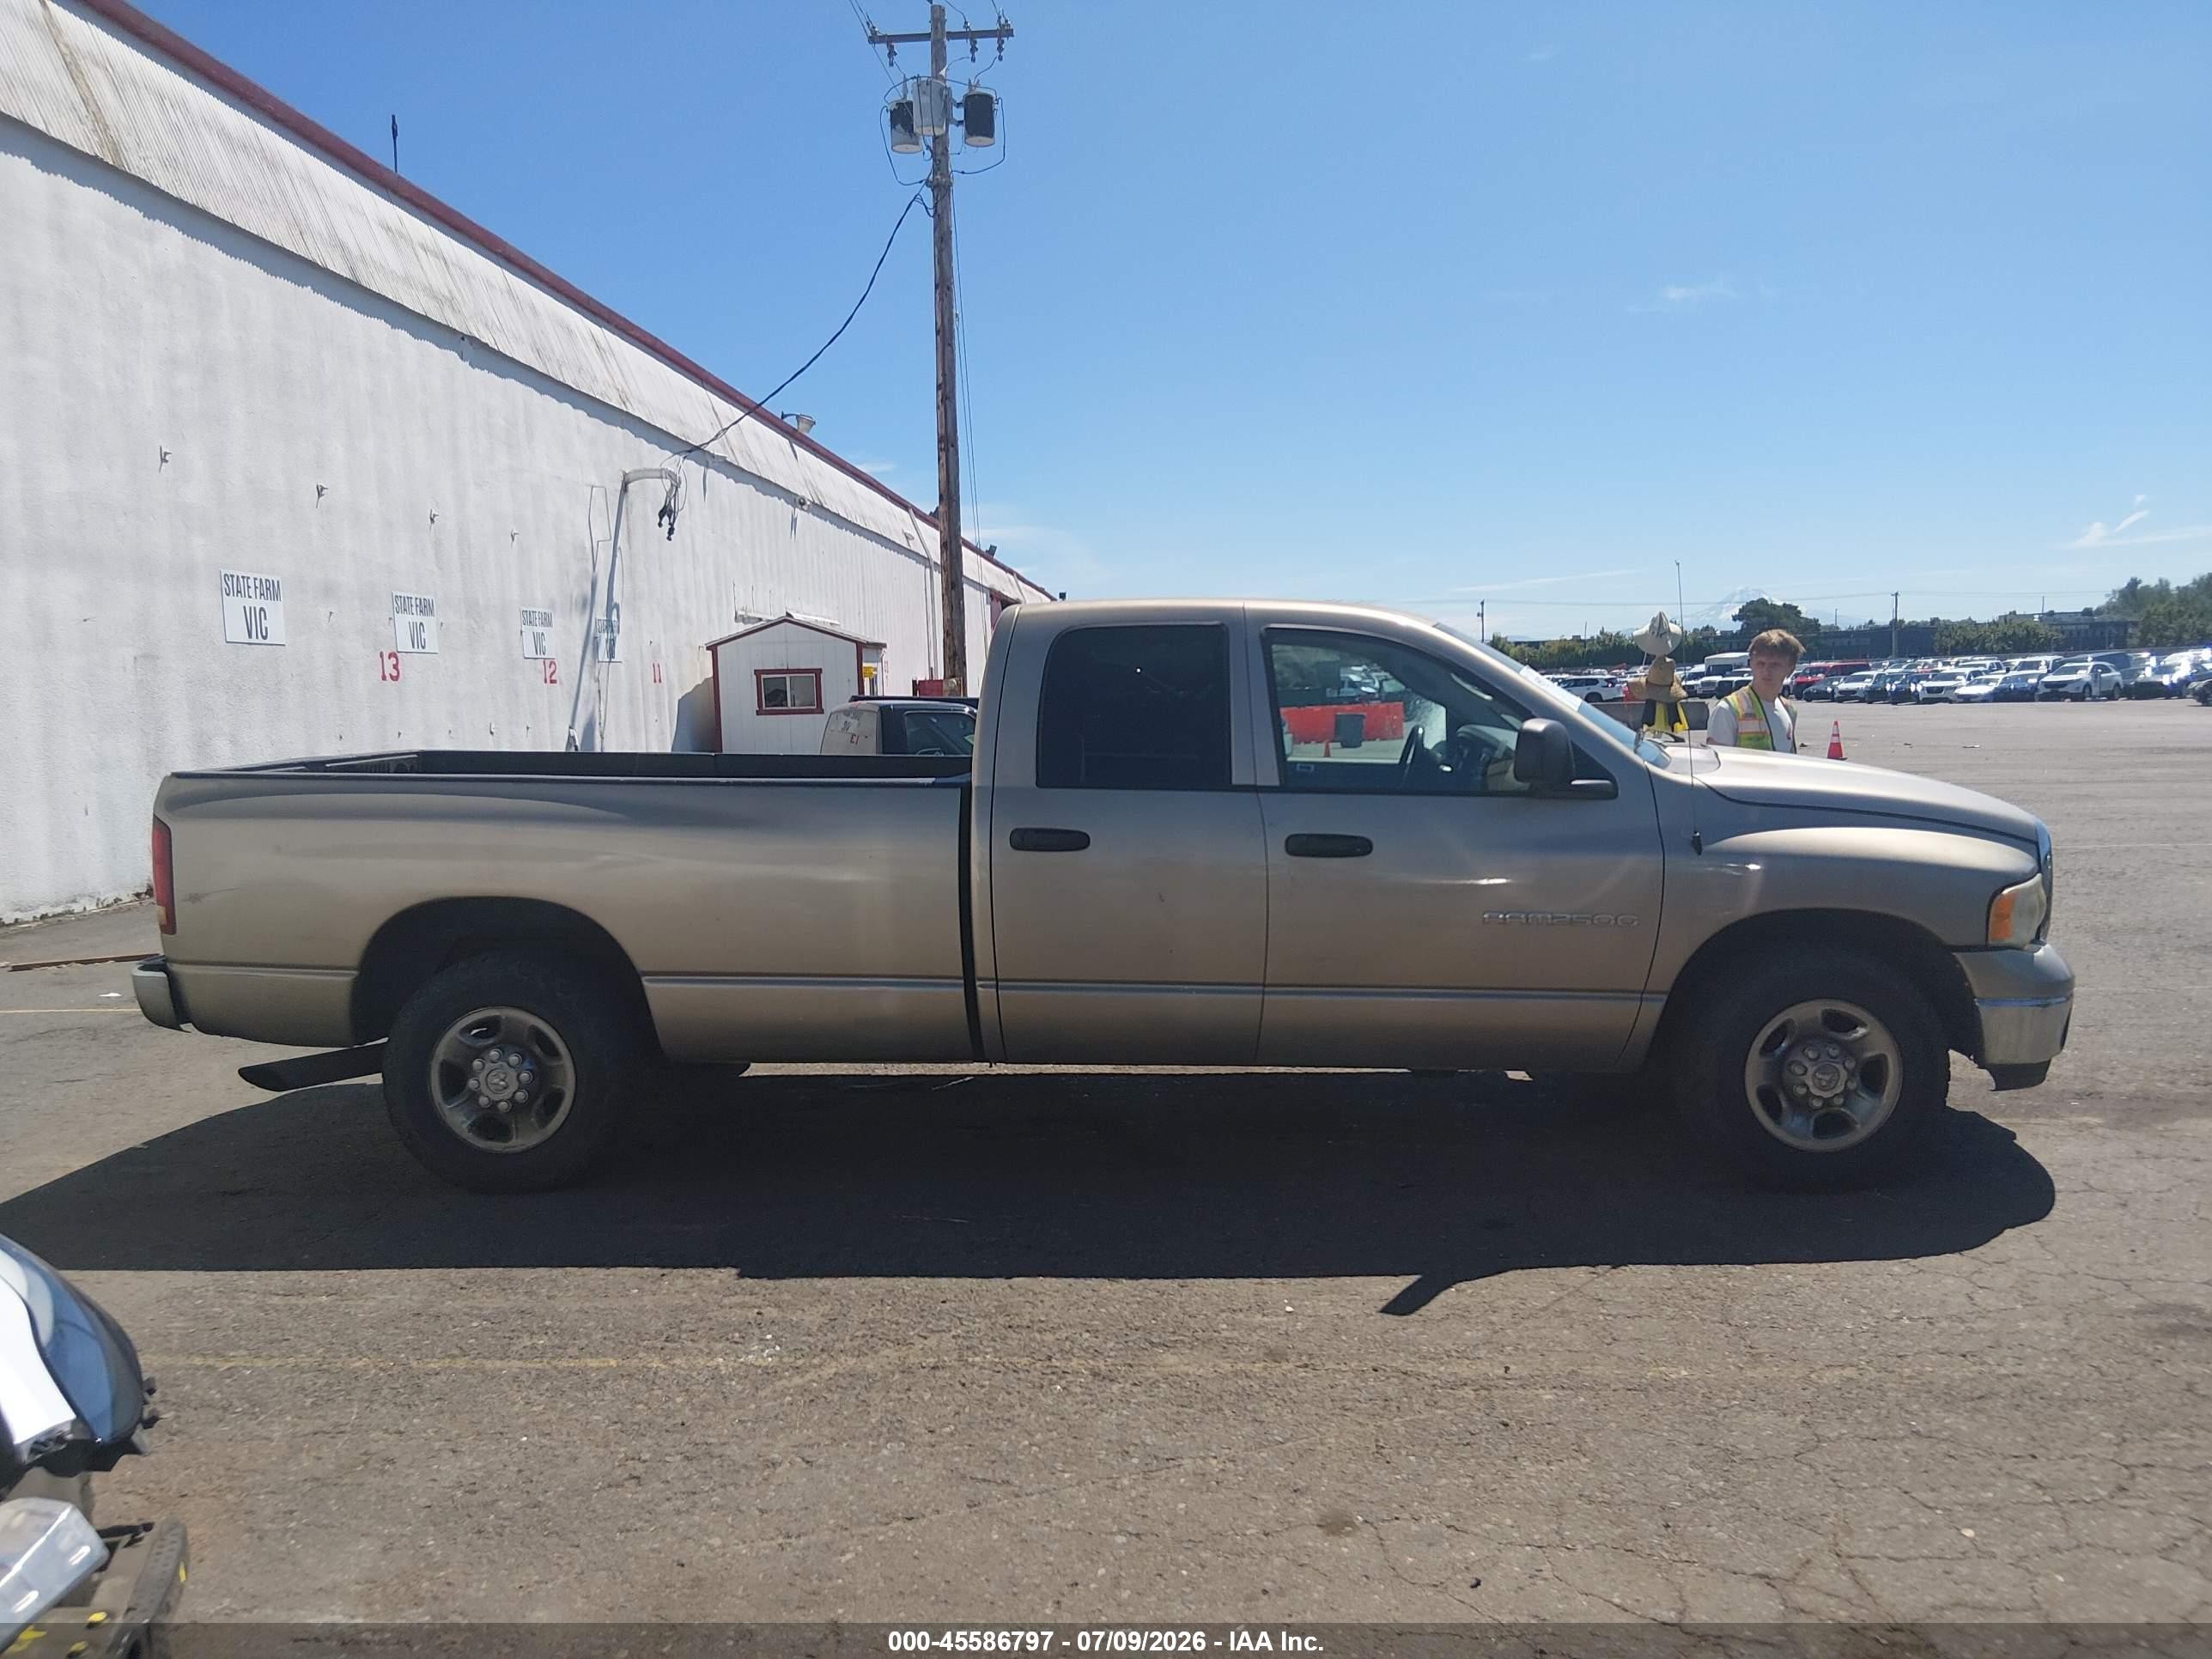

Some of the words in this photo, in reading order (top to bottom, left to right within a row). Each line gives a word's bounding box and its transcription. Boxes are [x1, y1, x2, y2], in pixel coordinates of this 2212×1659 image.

[223, 573, 252, 599] STATE
[253, 577, 282, 602] FARM
[395, 595, 414, 616] STATE
[415, 597, 435, 618] FARM
[522, 610, 538, 627] STATE
[538, 611, 553, 628] FARM
[243, 605, 269, 641] VIC
[408, 621, 426, 650] VIC
[532, 631, 546, 655] VIC
[380, 651, 400, 682] 13
[543, 659, 557, 684] 12
[653, 662, 662, 684] 11
